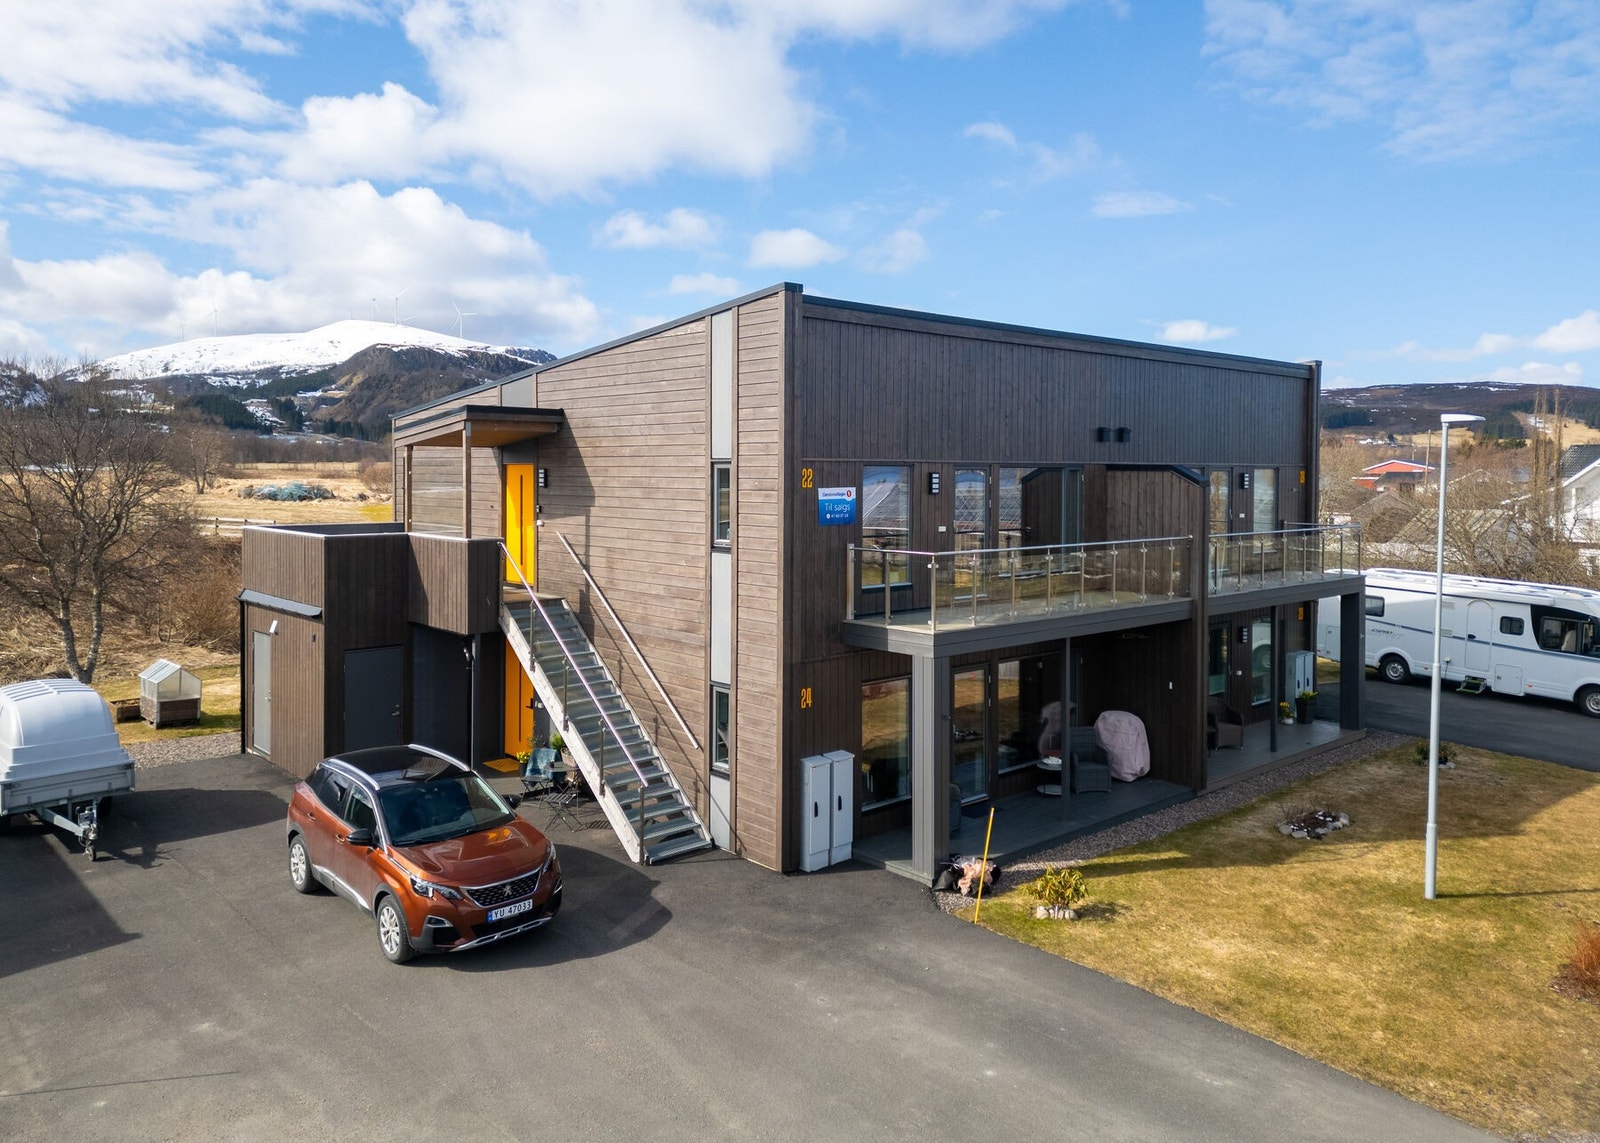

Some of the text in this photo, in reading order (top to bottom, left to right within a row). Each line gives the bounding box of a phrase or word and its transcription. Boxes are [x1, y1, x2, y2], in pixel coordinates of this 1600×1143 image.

[801, 468, 813, 488] 22
[824, 502, 851, 513] Til salgs
[801, 687, 812, 709] 24
[494, 900, 531, 919] YU 47033
